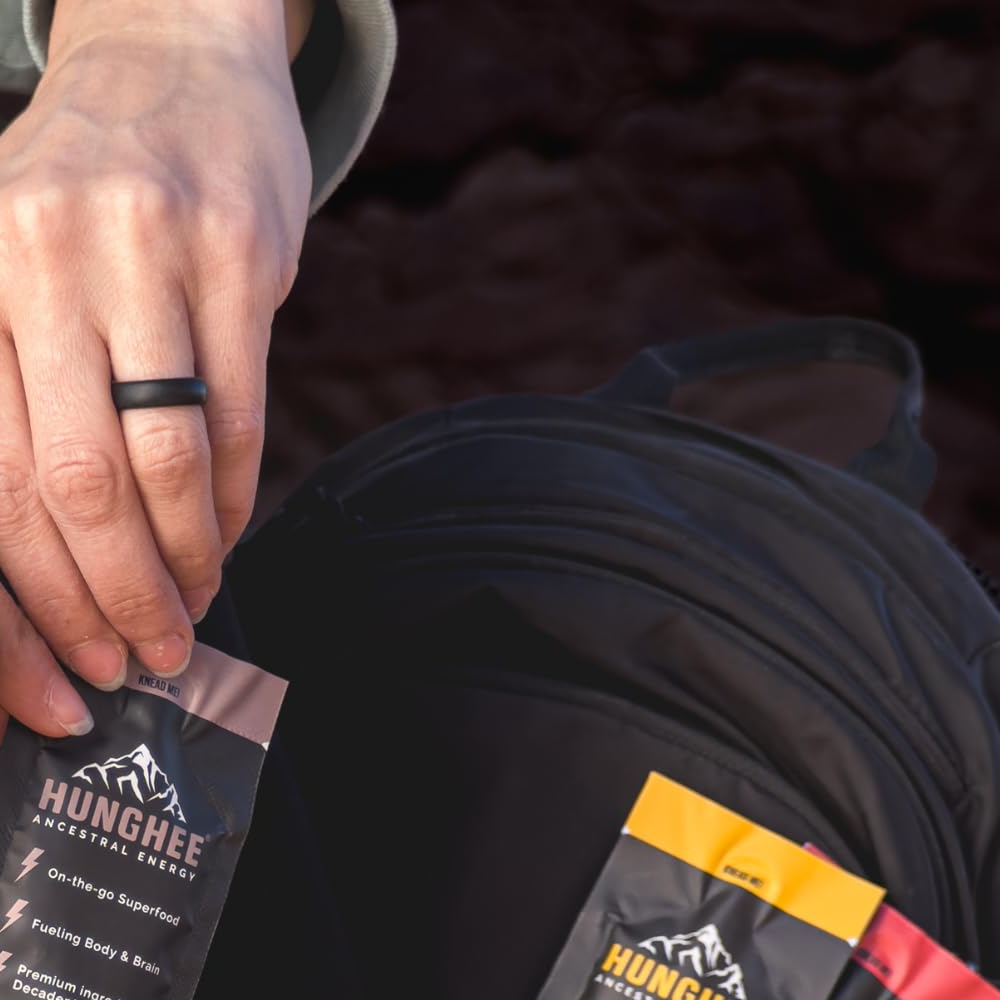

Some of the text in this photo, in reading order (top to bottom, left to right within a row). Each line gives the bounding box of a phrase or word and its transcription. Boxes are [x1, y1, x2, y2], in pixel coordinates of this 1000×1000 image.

[32, 814, 196, 882] ANCESTRAL ENERGY
[38, 778, 204, 868] HUNGHEE
[48, 867, 181, 927] On-the-go Superfood
[31, 918, 161, 976] Fueling Body & Brain
[16, 964, 77, 994] Premium
